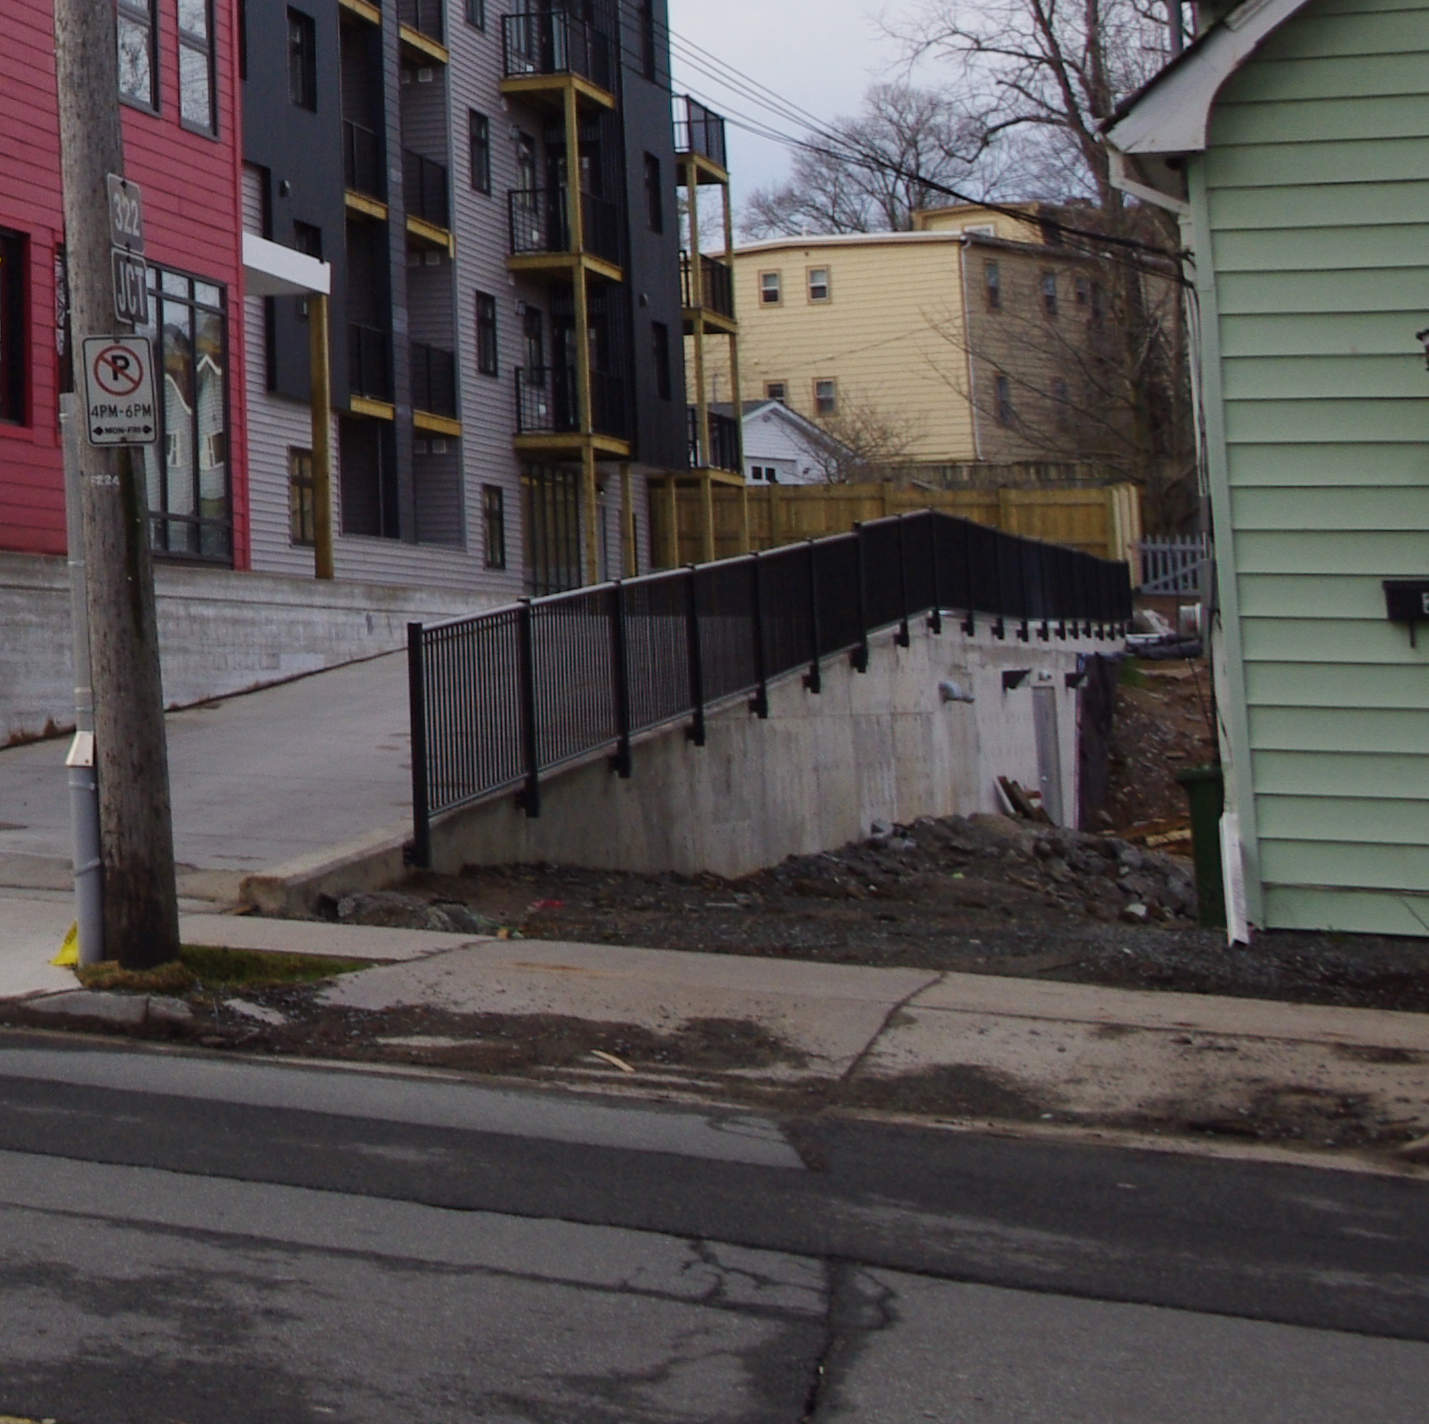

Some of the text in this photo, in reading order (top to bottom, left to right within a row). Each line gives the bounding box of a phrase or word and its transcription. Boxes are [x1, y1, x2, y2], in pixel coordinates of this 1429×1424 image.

[114, 192, 140, 237] 322
[118, 261, 146, 317] JCT
[91, 404, 151, 418] 4PM-6PM
[105, 426, 141, 435] MON-FRI
